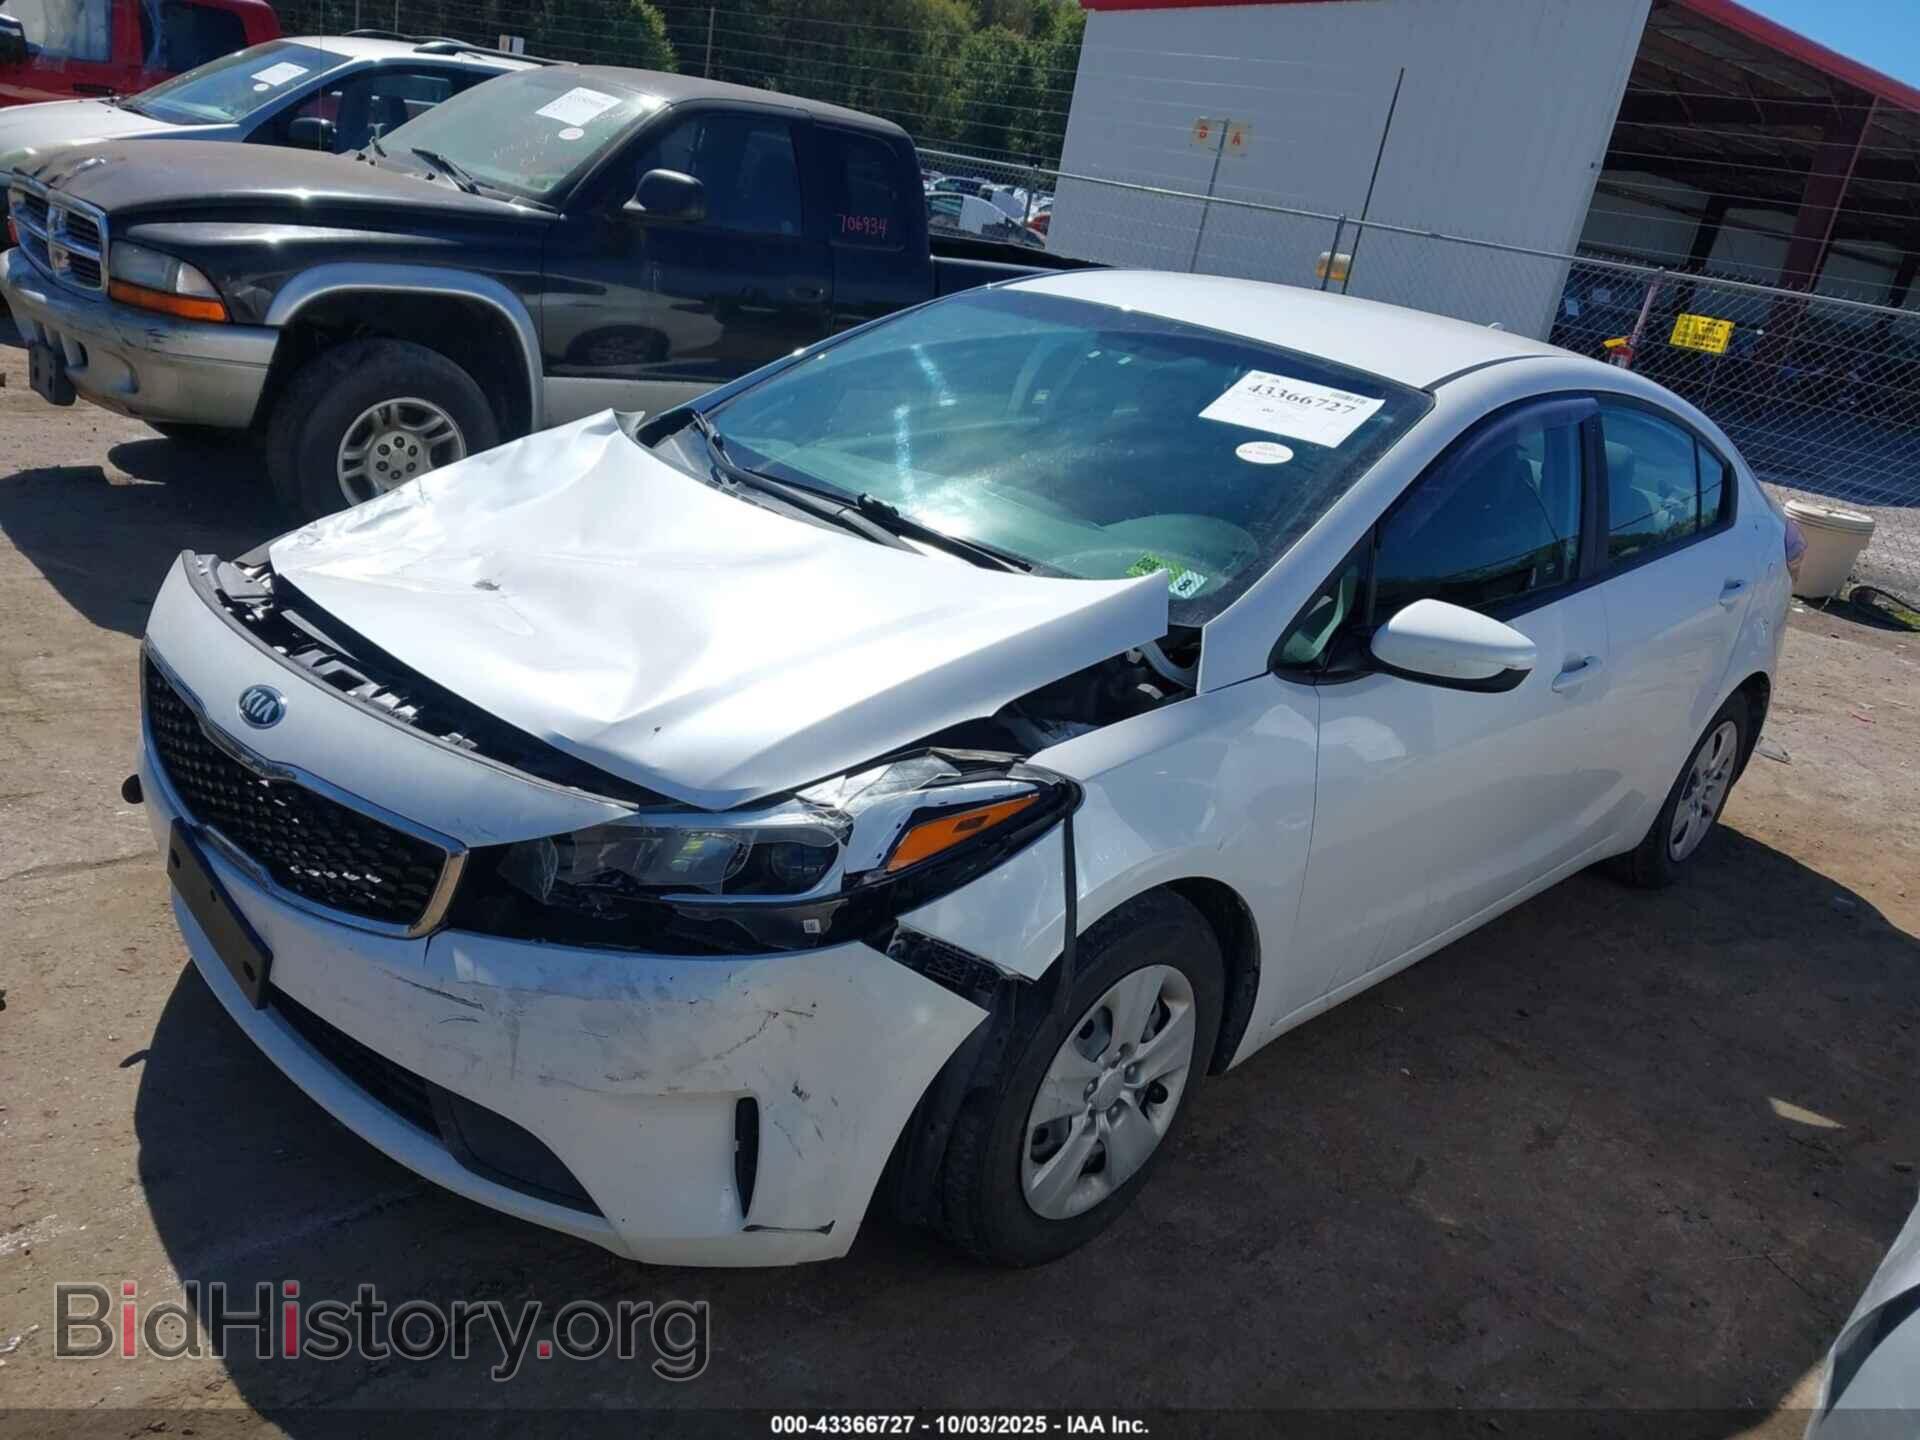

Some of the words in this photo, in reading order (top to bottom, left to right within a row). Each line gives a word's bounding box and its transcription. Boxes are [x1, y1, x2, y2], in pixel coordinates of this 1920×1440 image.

[834, 213, 887, 239] 706934
[1248, 384, 1356, 415] 43366727
[241, 689, 275, 722] KIA
